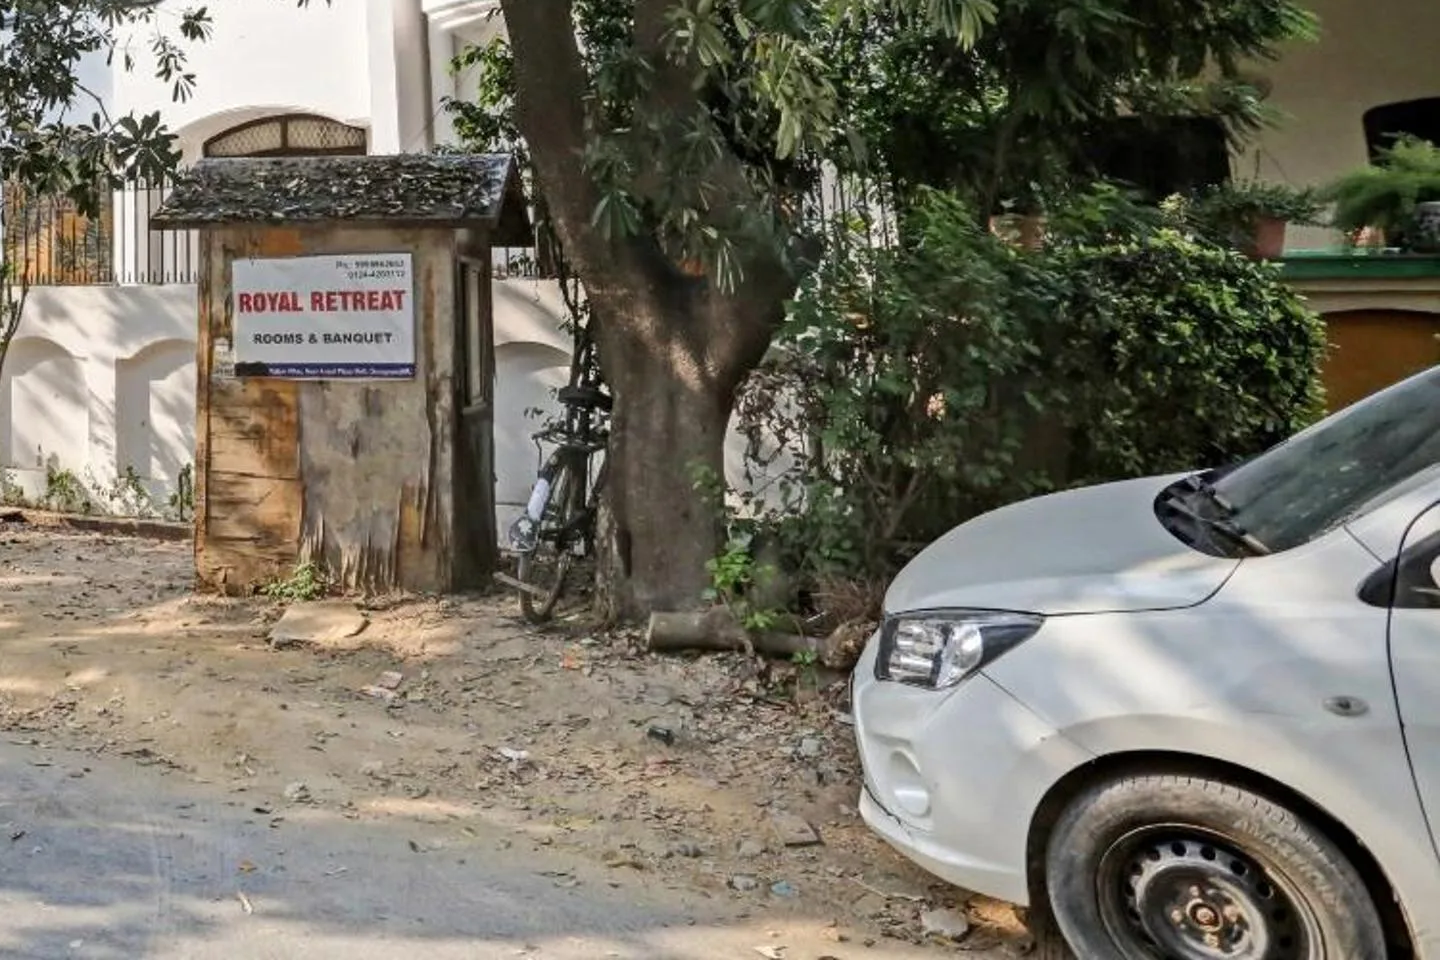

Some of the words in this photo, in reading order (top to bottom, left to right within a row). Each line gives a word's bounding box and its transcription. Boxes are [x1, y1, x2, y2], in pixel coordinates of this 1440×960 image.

[239, 292, 303, 313] ROYAL
[310, 290, 406, 311] RETREAT
[253, 333, 303, 344] ROOMS
[308, 333, 318, 344] &
[323, 332, 393, 344] BANQUET
